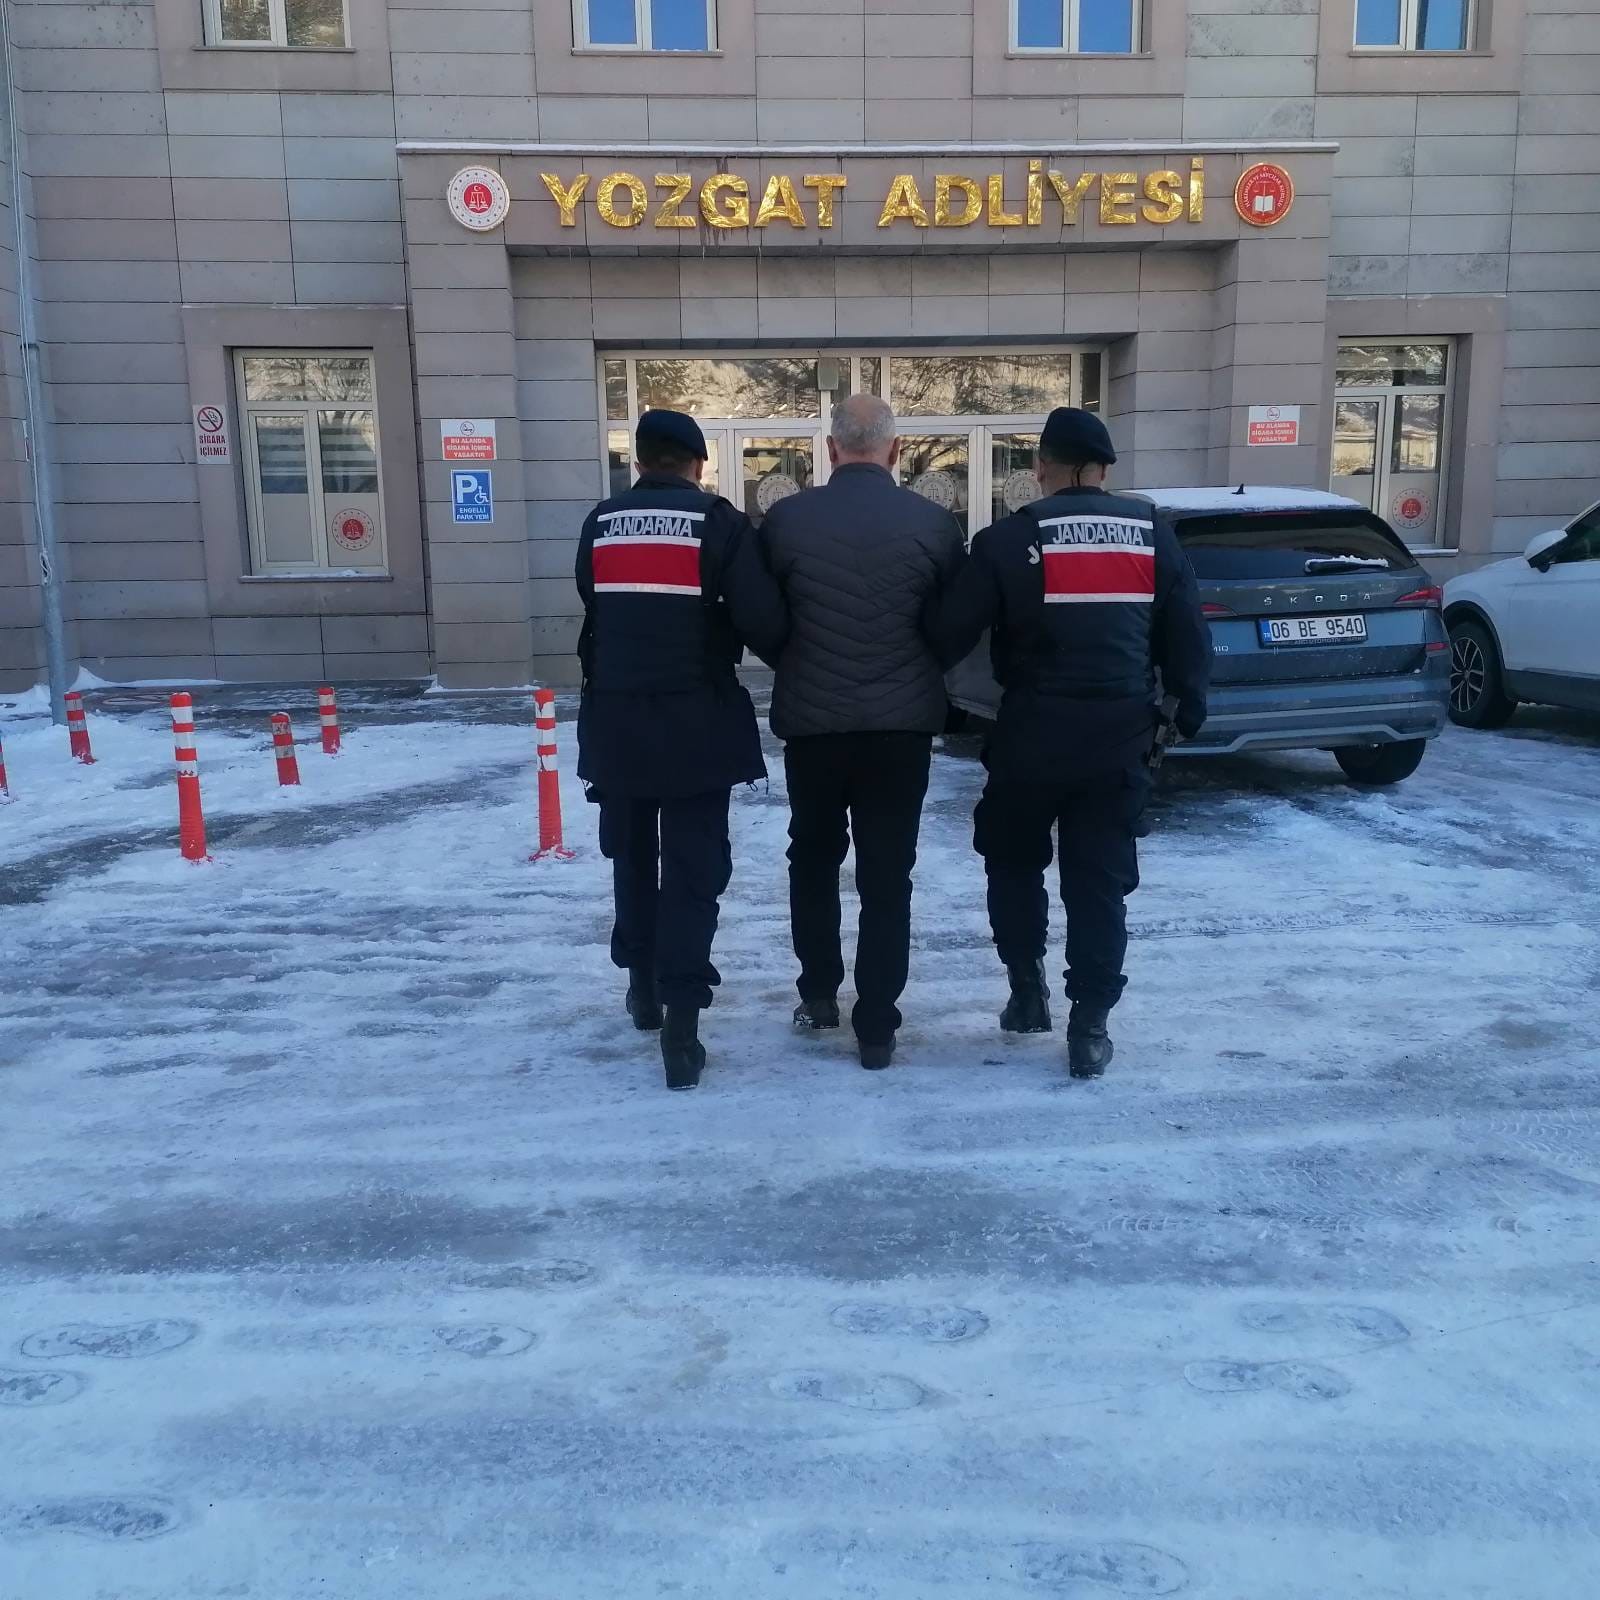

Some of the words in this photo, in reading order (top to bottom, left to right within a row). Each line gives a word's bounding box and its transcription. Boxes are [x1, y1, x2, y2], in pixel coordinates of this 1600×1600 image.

[540, 172, 848, 229] YOZGAT
[876, 157, 1204, 227] ADLİYESİ
[199, 434, 226, 444] SİGARA
[455, 474, 478, 503] P
[604, 516, 693, 538] JANDARMA
[1052, 523, 1145, 547] JANDARMA
[1271, 621, 1290, 639] 06
[1299, 620, 1318, 638] BE
[1326, 617, 1364, 636] 9540
